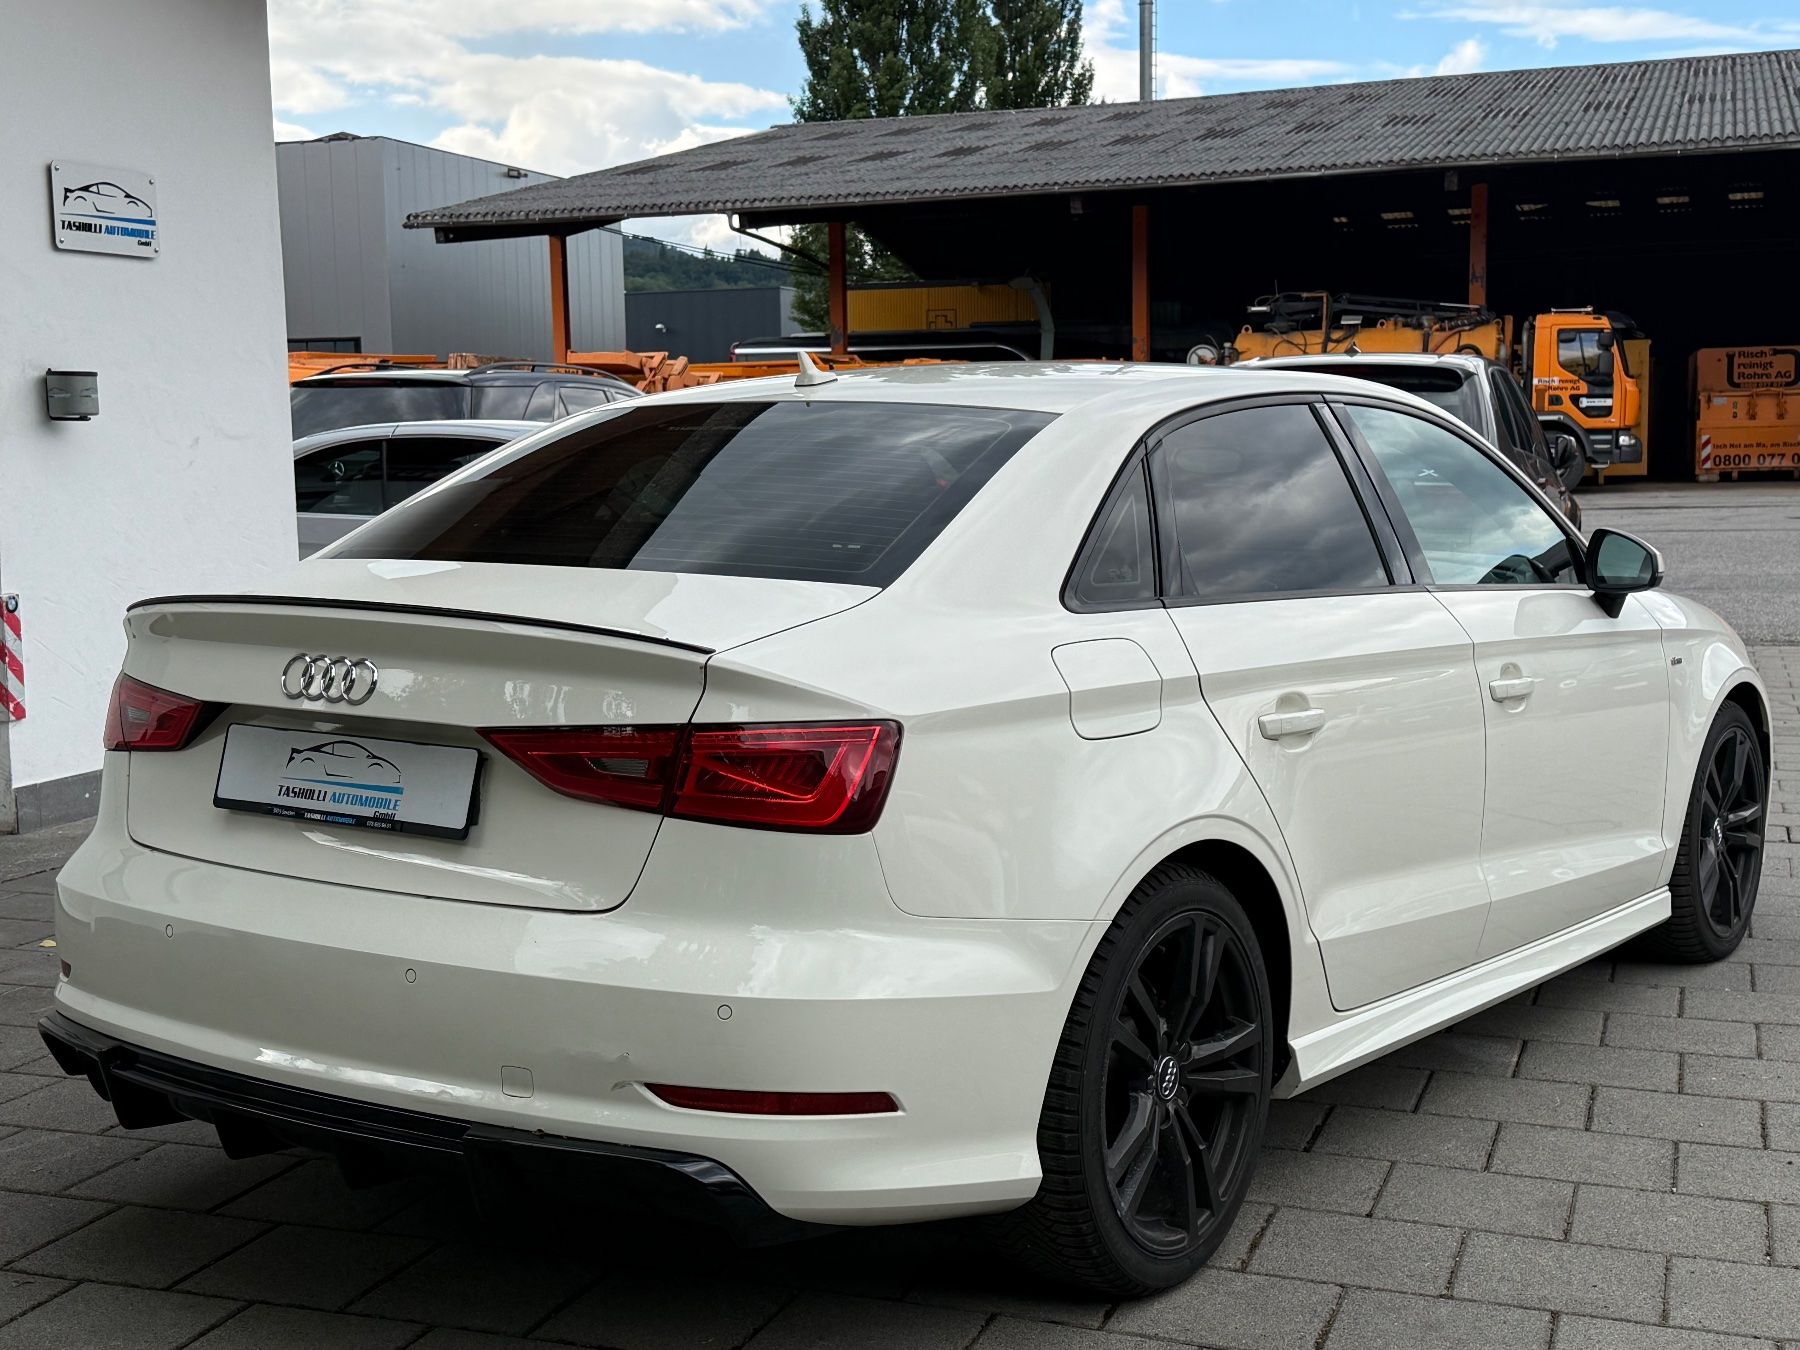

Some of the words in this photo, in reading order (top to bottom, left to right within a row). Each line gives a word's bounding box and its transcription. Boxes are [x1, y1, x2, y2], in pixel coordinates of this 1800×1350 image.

[60, 220, 102, 234] TASHOLLI
[104, 224, 156, 240] AUTOMOBILE
[1738, 350, 1767, 358] Risch
[1738, 361, 1774, 370] reinigt
[1738, 371, 1772, 380] Rohre
[1775, 370, 1792, 379] AG
[1713, 454, 1752, 467] 0800
[1757, 453, 1786, 465] 077
[278, 785, 327, 802] TASHOLLI
[329, 791, 401, 811] AUTOMOBILE
[374, 810, 396, 820] GmbH
